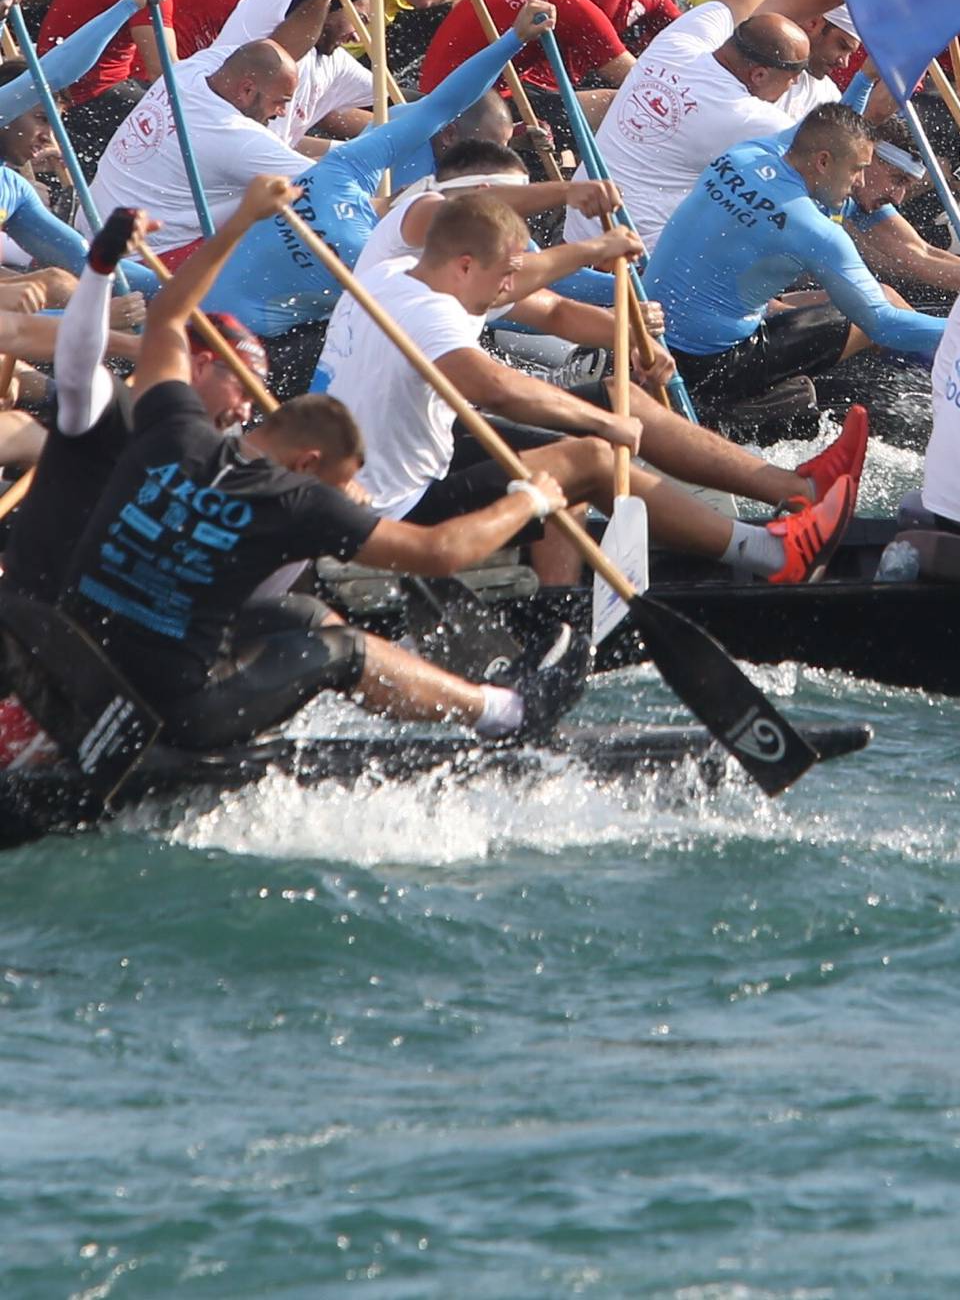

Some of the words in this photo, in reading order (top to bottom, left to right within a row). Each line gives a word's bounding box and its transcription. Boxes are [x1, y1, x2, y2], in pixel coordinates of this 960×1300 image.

[644, 65, 699, 115] SISAK
[703, 178, 759, 229] MOMIĆI
[709, 153, 789, 231] ŠKRAPA
